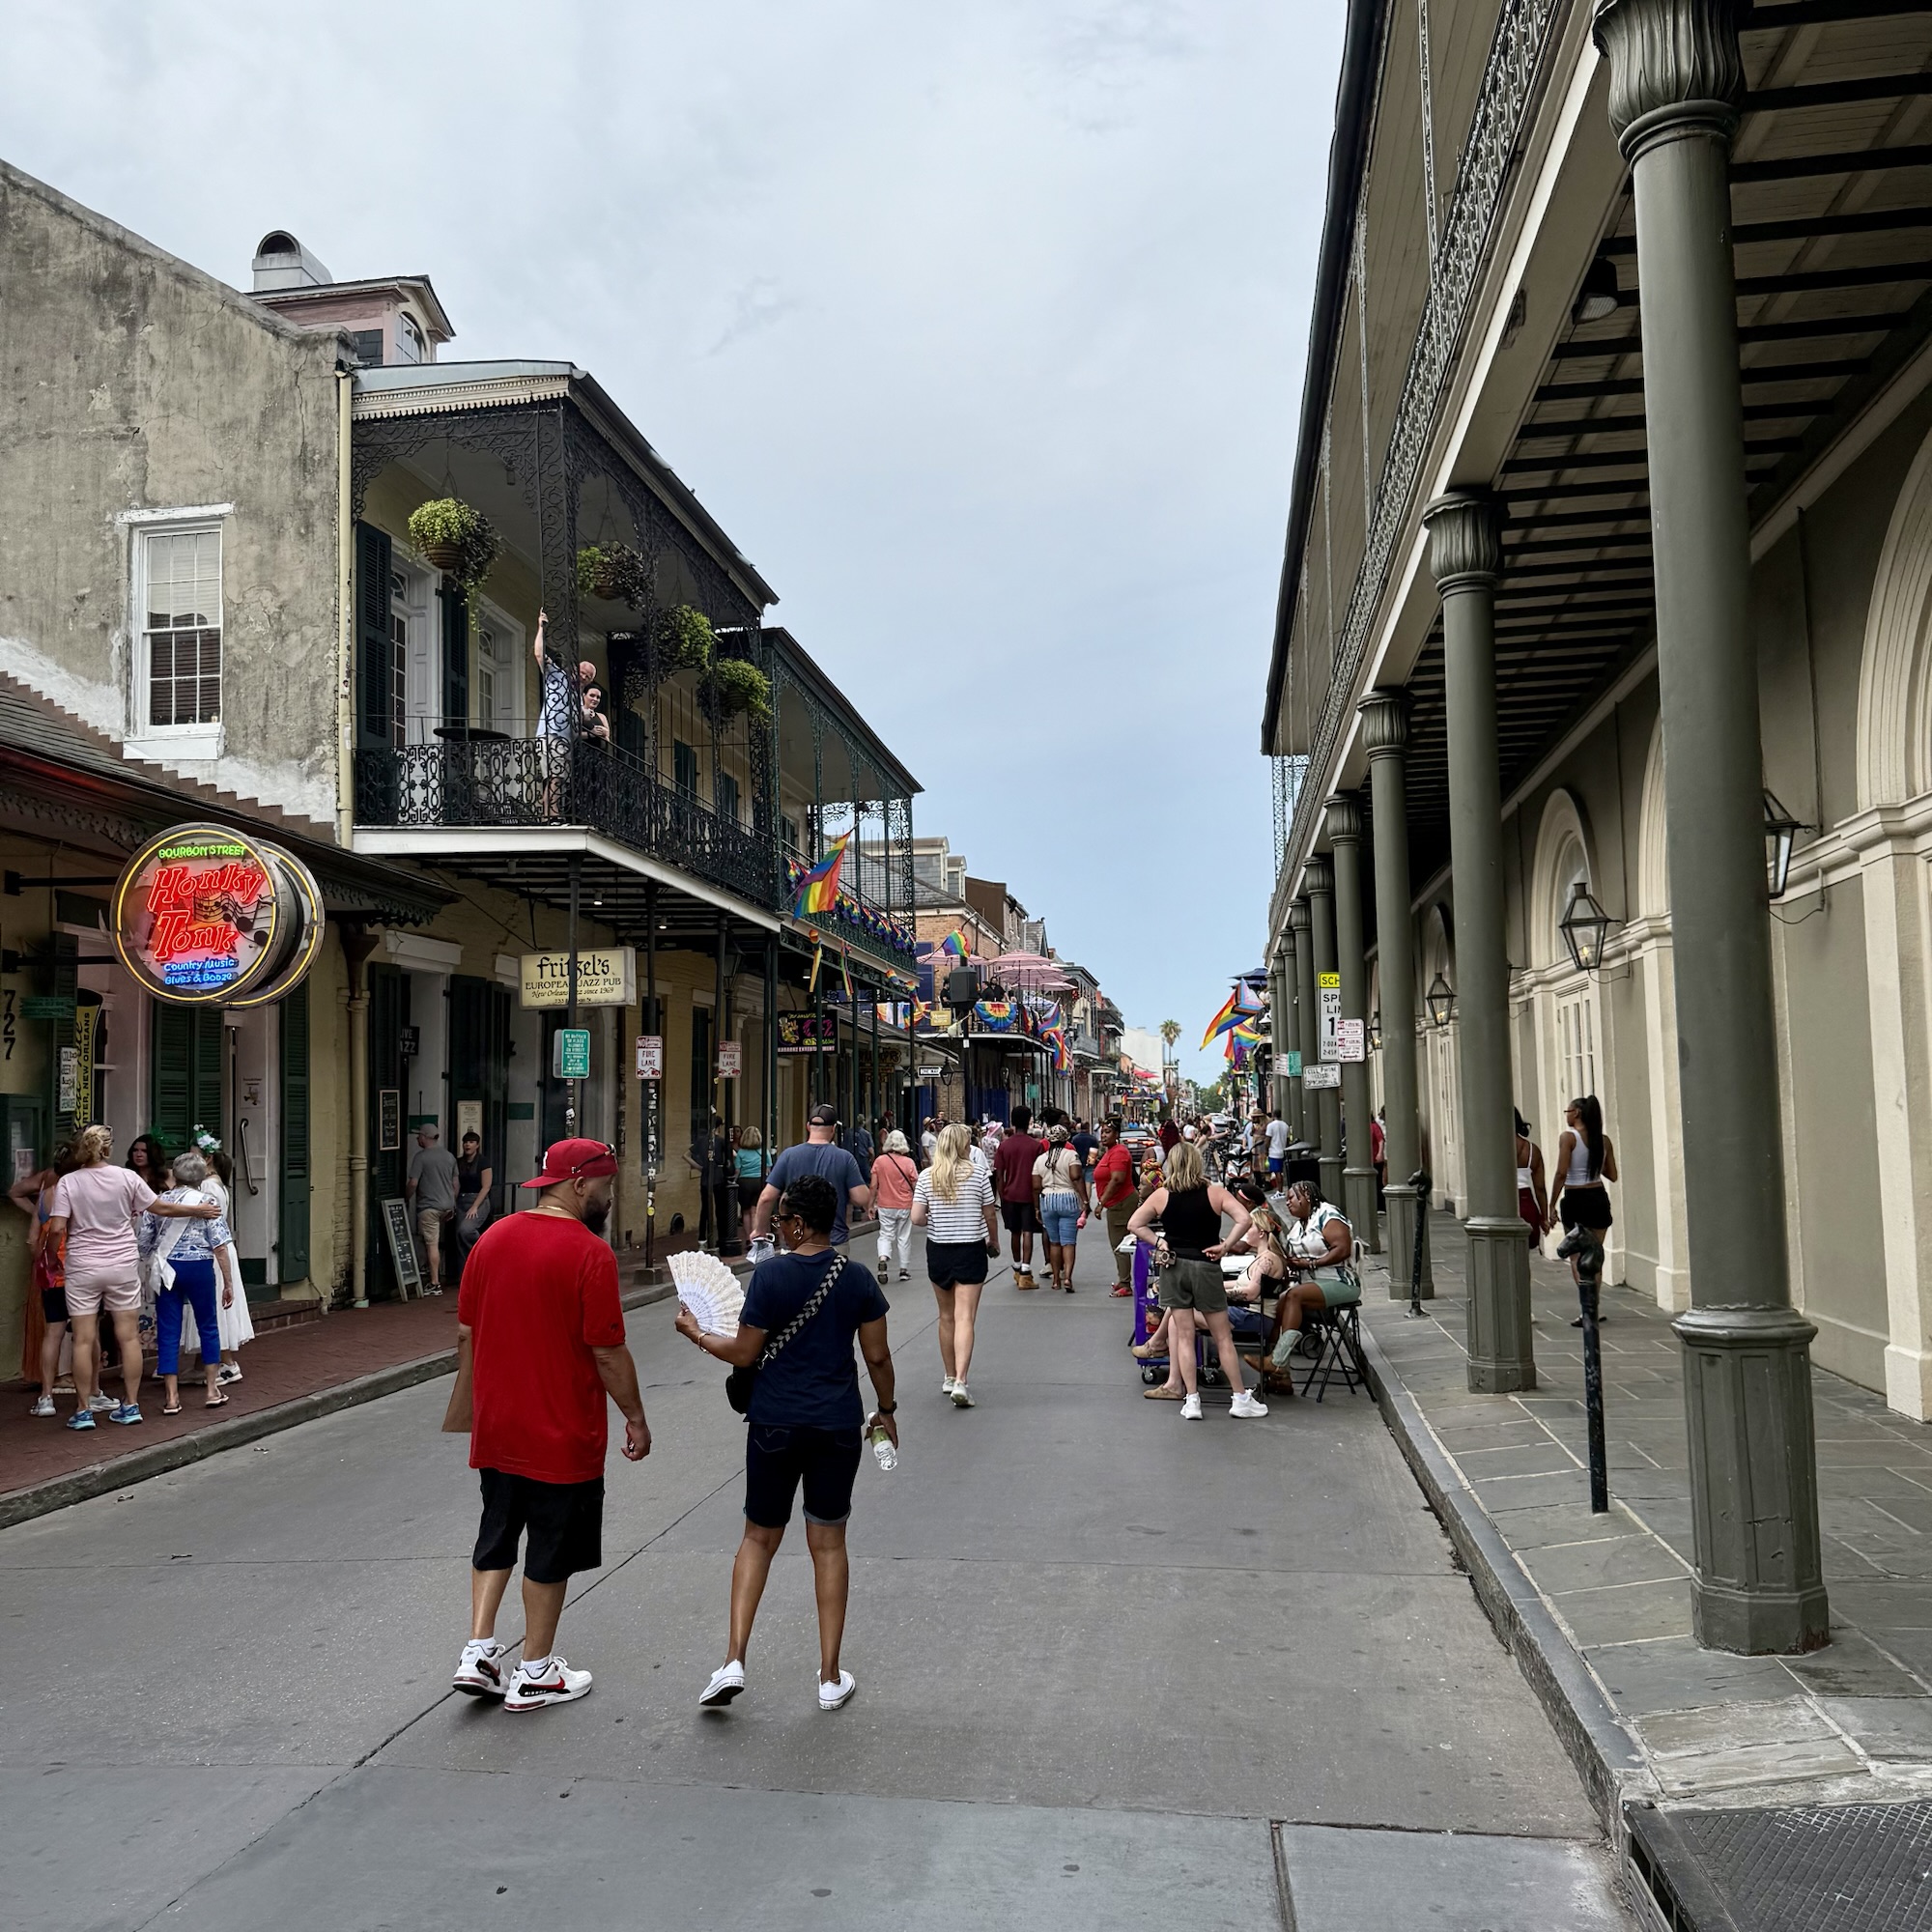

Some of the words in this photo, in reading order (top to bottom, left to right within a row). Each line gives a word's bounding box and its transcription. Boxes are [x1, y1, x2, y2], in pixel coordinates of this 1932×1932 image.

[158, 846, 208, 859] BOURBON
[209, 844, 245, 856] STREET
[147, 863, 263, 912] Honky
[154, 910, 237, 958] Tonk
[163, 960, 203, 972] Country
[205, 958, 235, 969] Music
[164, 975, 192, 984] Blues
[193, 974, 202, 983] &
[203, 972, 233, 982] Booze
[526, 980, 569, 990] EUROPEA
[579, 979, 601, 987] JAZZ
[603, 978, 622, 986] PUB
[1322, 977, 1340, 985] SCH
[531, 989, 546, 999] New
[1328, 1017, 1335, 1036] 1
[400, 1028, 413, 1038] IVE
[638, 1037, 645, 1048] NO
